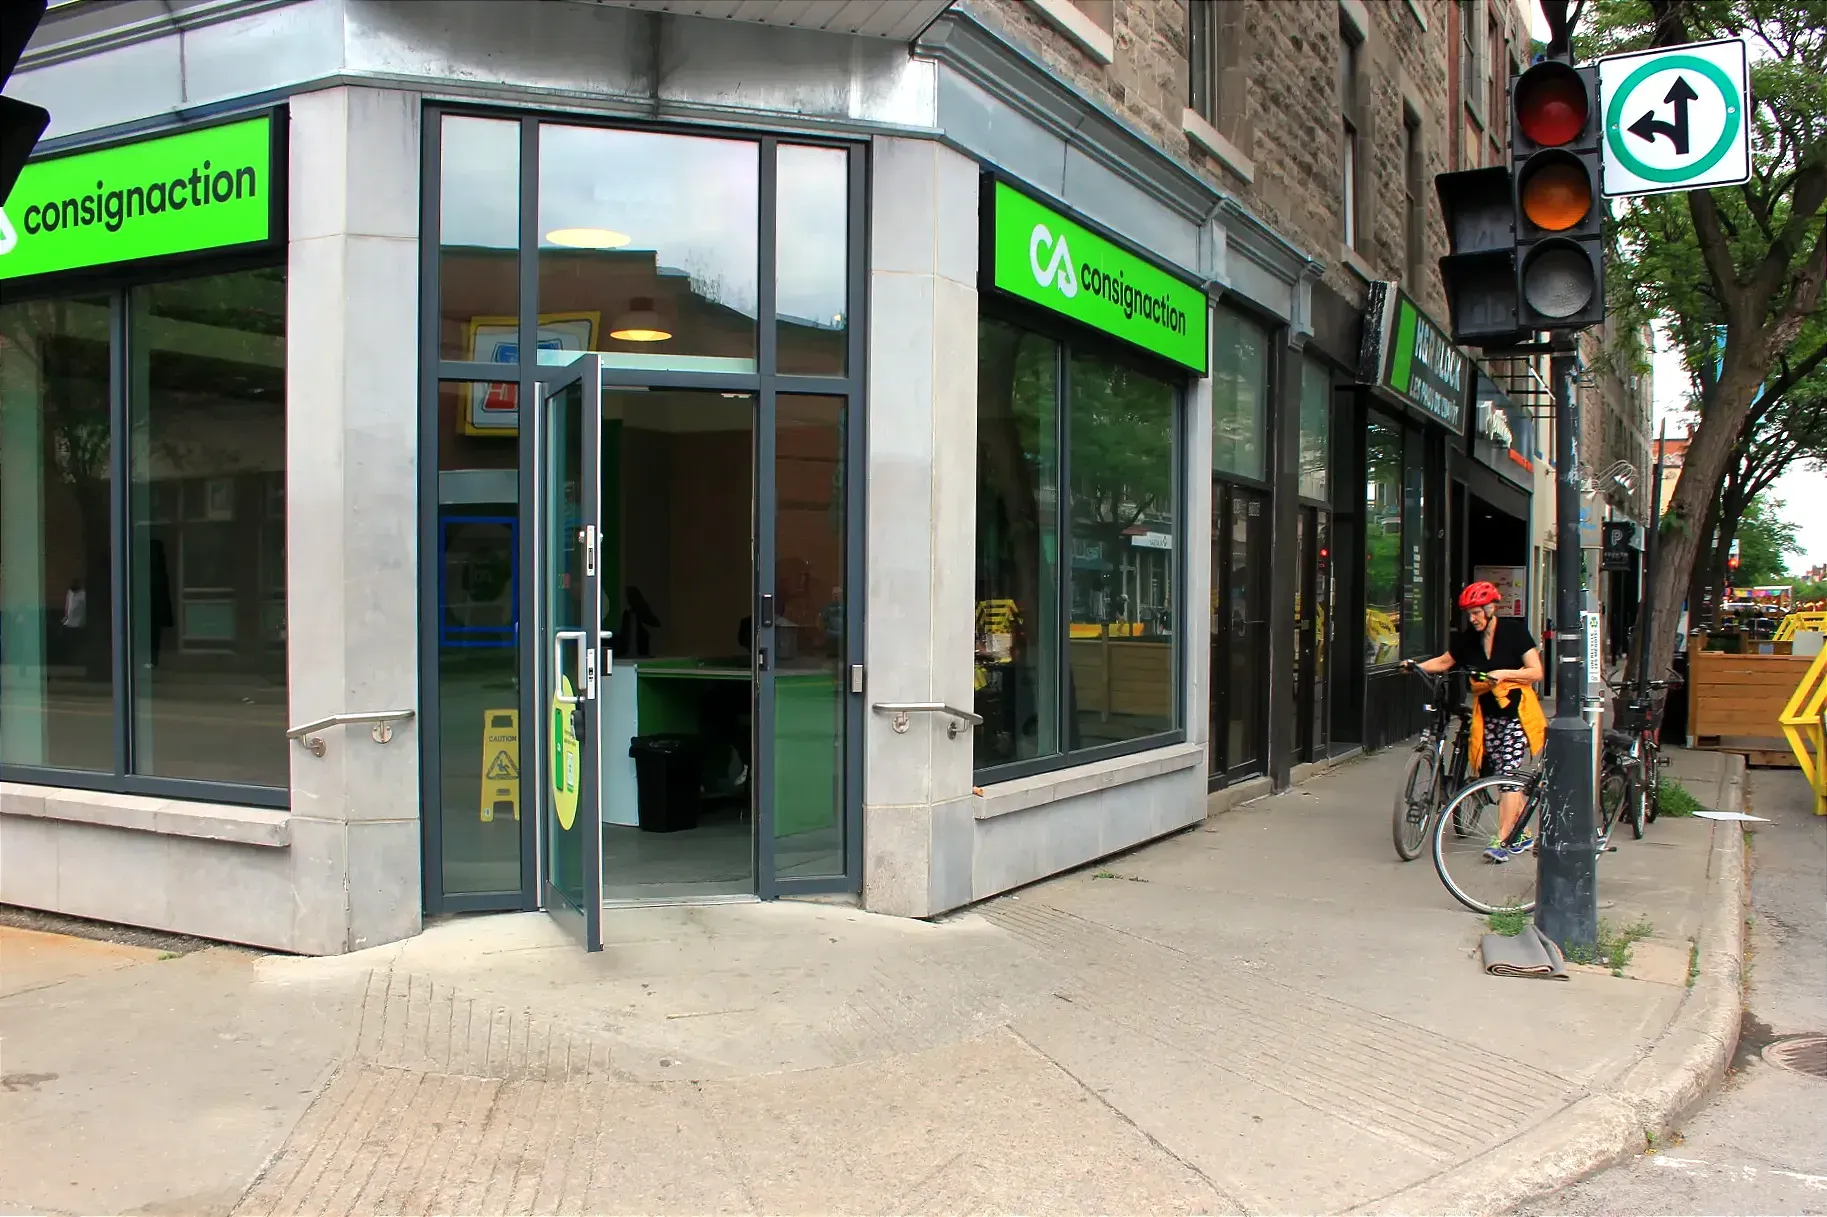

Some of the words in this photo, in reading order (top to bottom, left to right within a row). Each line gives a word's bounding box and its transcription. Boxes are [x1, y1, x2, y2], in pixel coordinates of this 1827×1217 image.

[23, 160, 256, 234] consignaction
[1081, 262, 1187, 336] consignaction
[1434, 337, 1462, 391] BLOCK
[488, 735, 517, 743] CAUTION
